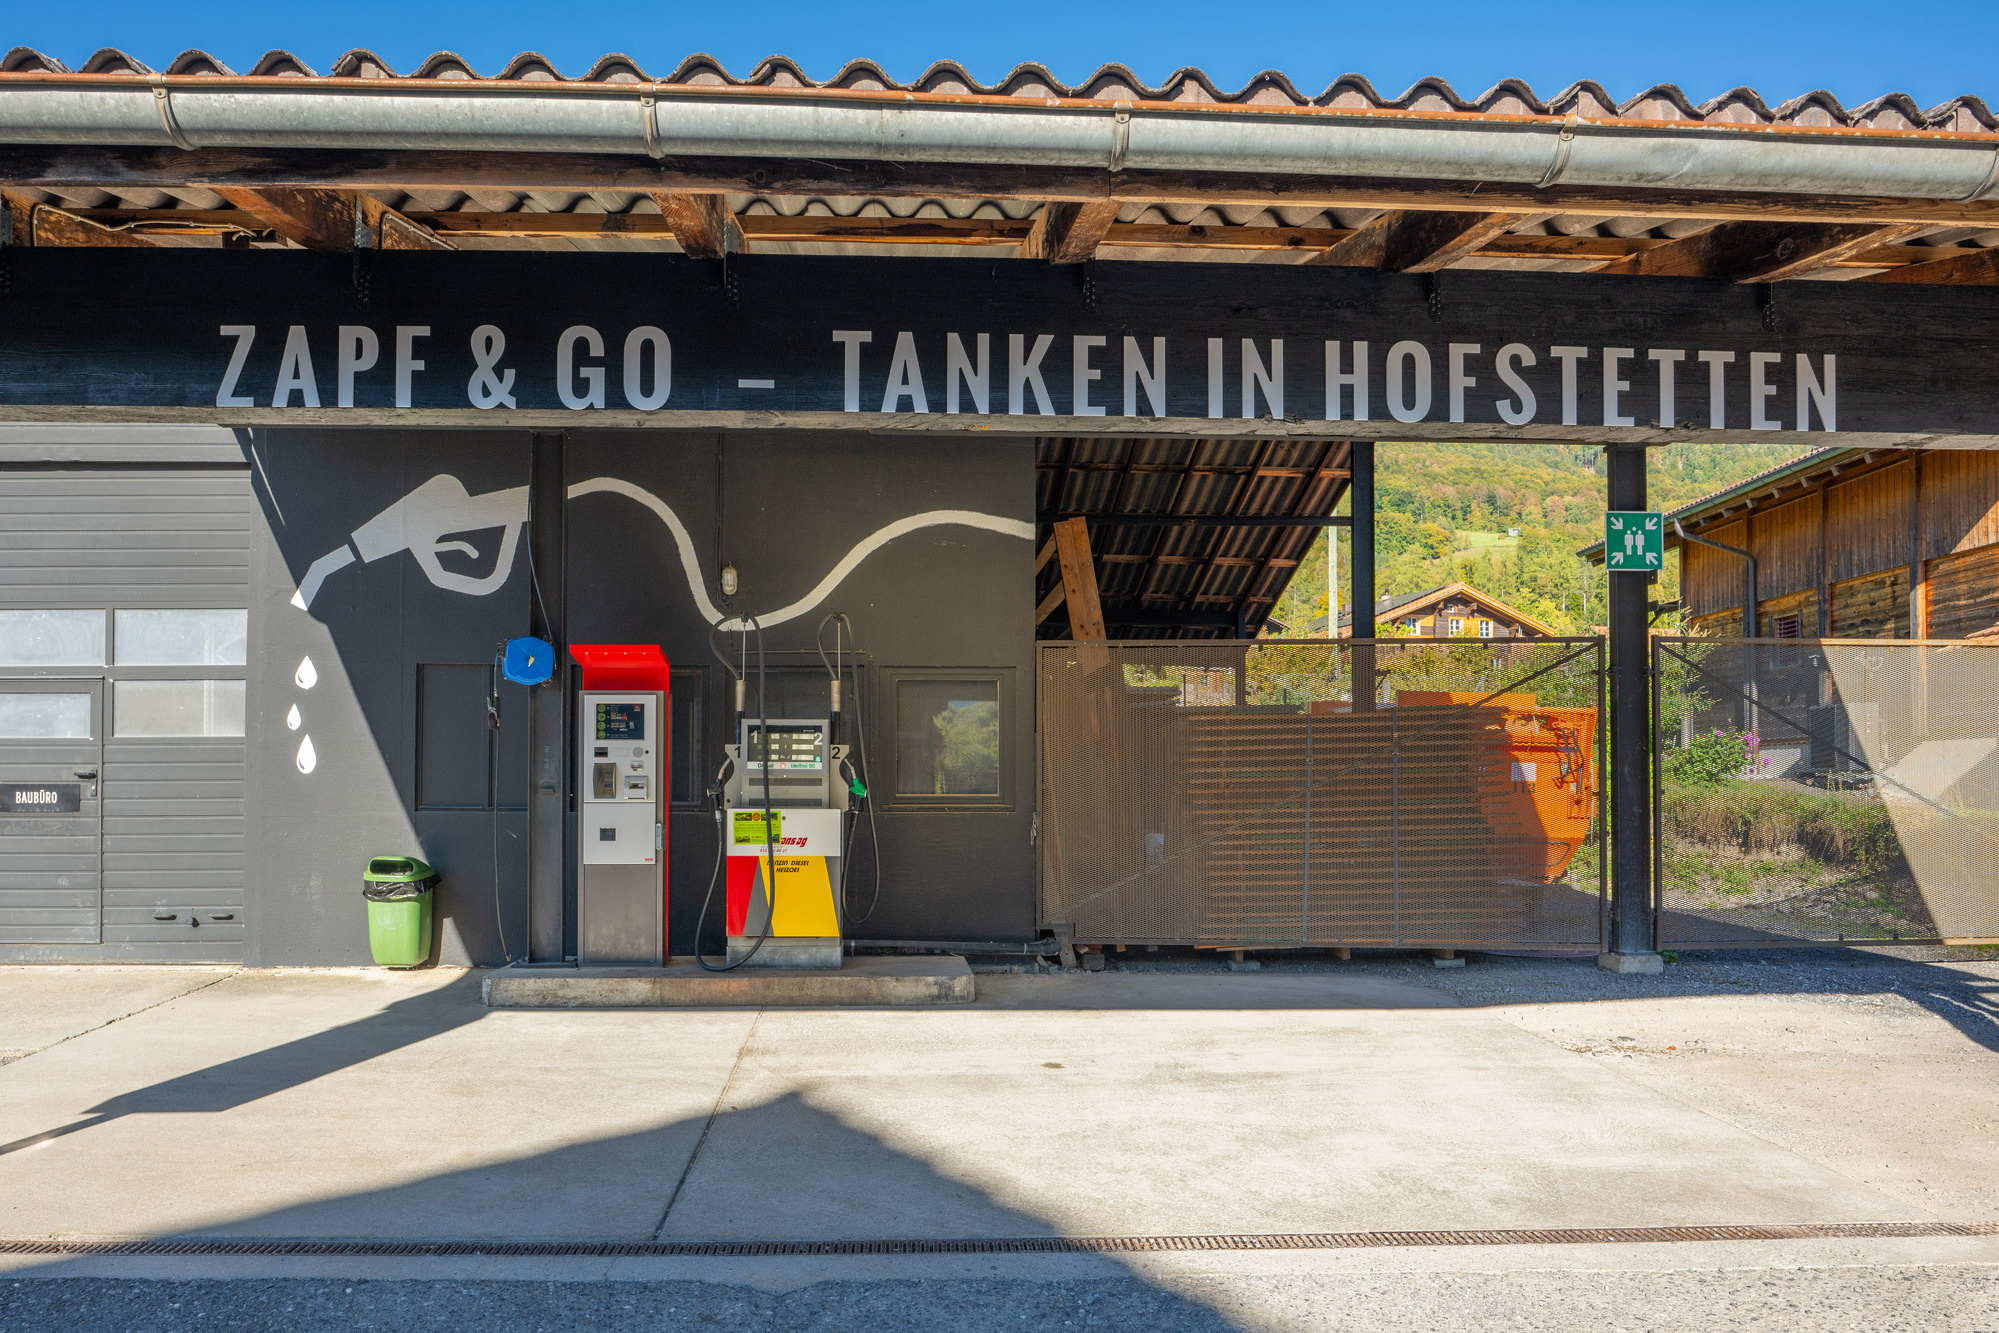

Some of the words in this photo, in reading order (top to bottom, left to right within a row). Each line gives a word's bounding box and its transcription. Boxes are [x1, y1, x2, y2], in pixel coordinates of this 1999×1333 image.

[216, 324, 432, 409] ZAPF
[467, 324, 517, 410] &
[557, 325, 672, 411] GO
[832, 330, 1166, 418] TANKEN
[1207, 338, 1284, 420] IN
[1325, 340, 1837, 433] HOFSTETTEN
[750, 730, 758, 744] 1
[814, 732, 823, 746] 2
[734, 745, 741, 759] 1
[831, 746, 841, 760] 2
[15, 789, 58, 804] BAUBÜRO
